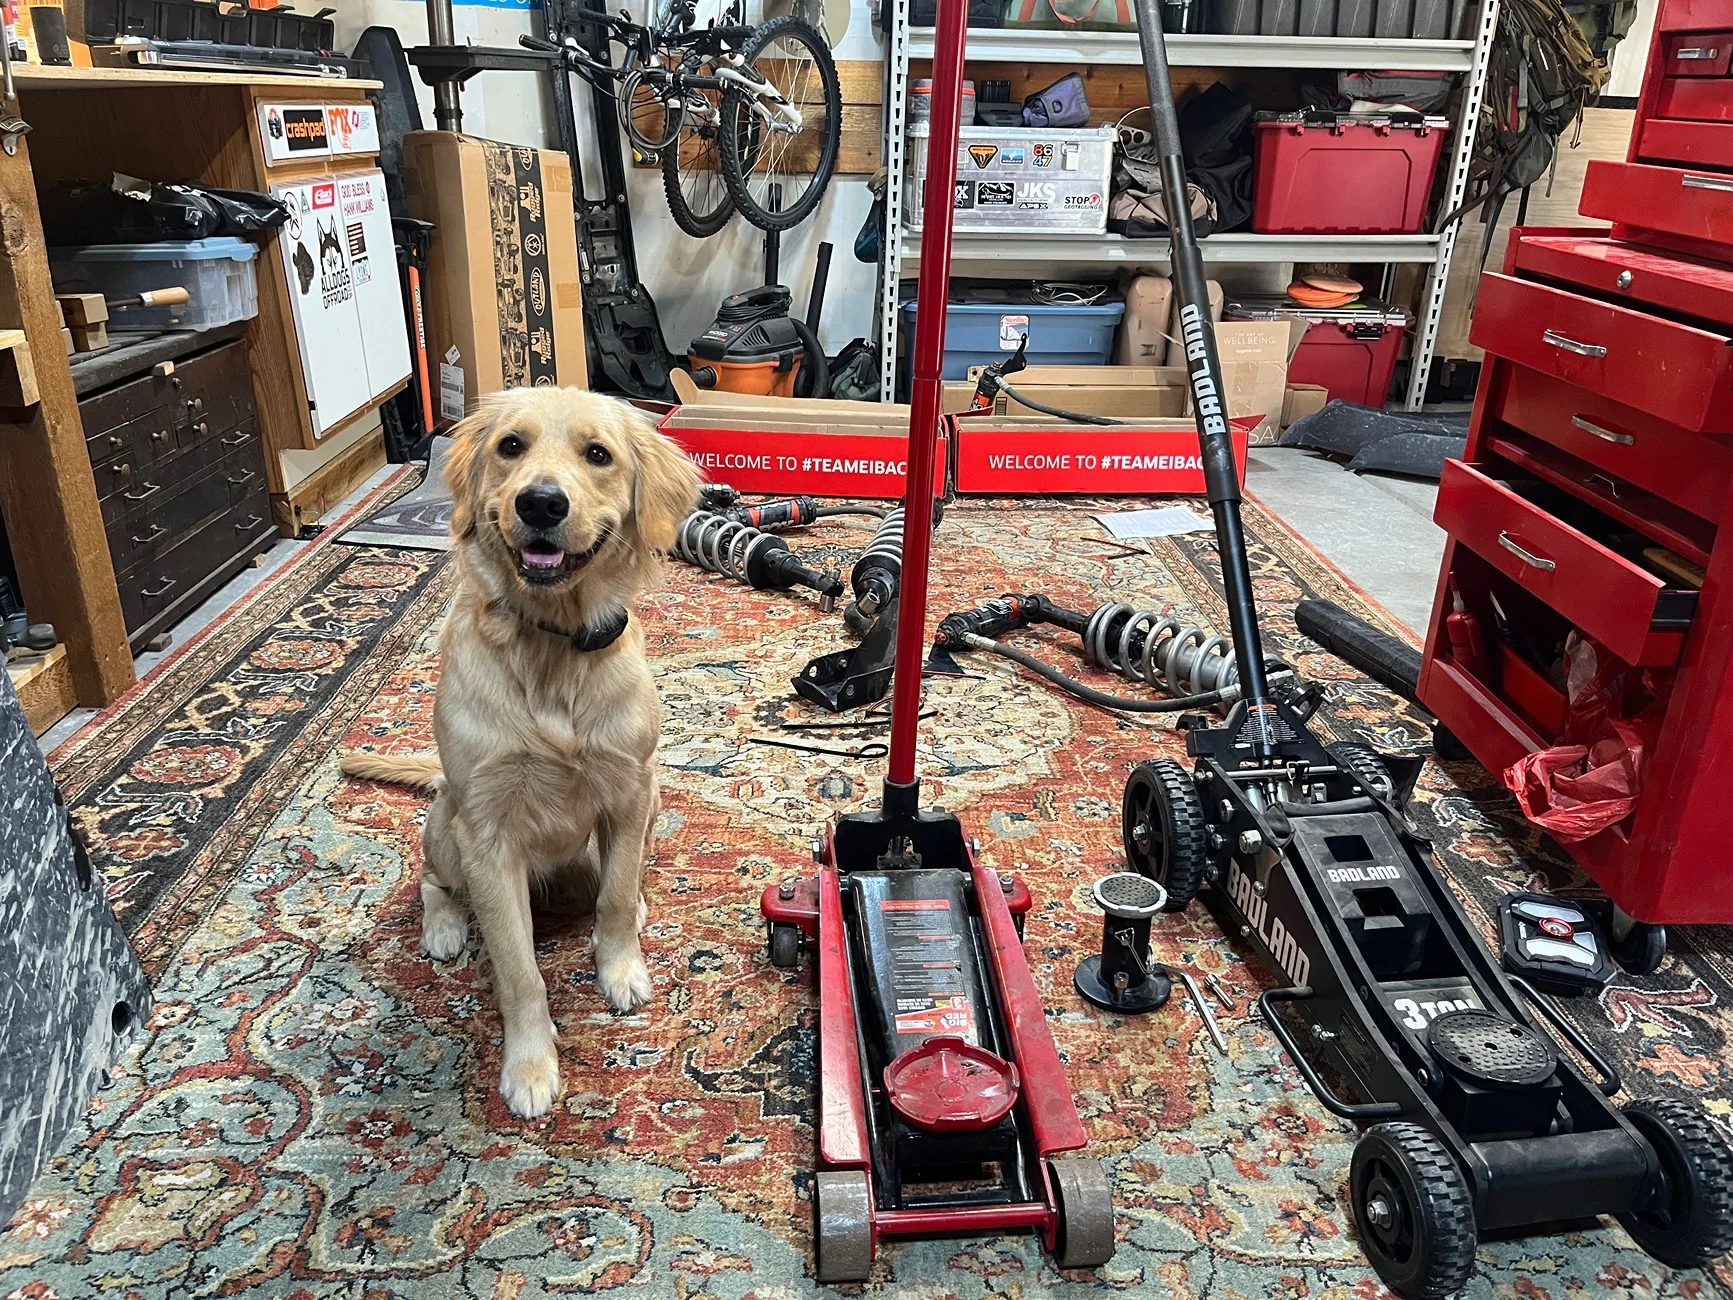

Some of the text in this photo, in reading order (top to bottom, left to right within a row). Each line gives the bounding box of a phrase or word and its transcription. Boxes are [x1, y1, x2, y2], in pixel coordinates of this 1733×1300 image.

[285, 117, 326, 142] crashpad
[327, 107, 352, 136] FOX
[1033, 144, 1054, 156] 86
[1033, 156, 1052, 167] 47
[341, 183, 366, 199] GOD BLESS
[1017, 182, 1056, 203] JKS
[1065, 196, 1090, 205] STOP
[343, 198, 375, 217] HANK WILLIAMS
[320, 268, 350, 294] ALLDOGS
[532, 271, 543, 310] OUTLAND
[322, 287, 349, 310] OFFROAD
[1180, 303, 1226, 435] BADLAND
[689, 452, 907, 475] WELCOME TO #TEAMEIBAC
[988, 455, 1204, 470] WELCOME TO #TEAMEIBAC
[1327, 865, 1401, 883] BADLAND
[1226, 857, 1310, 988] BADLAND
[1394, 998, 1428, 1030] 3
